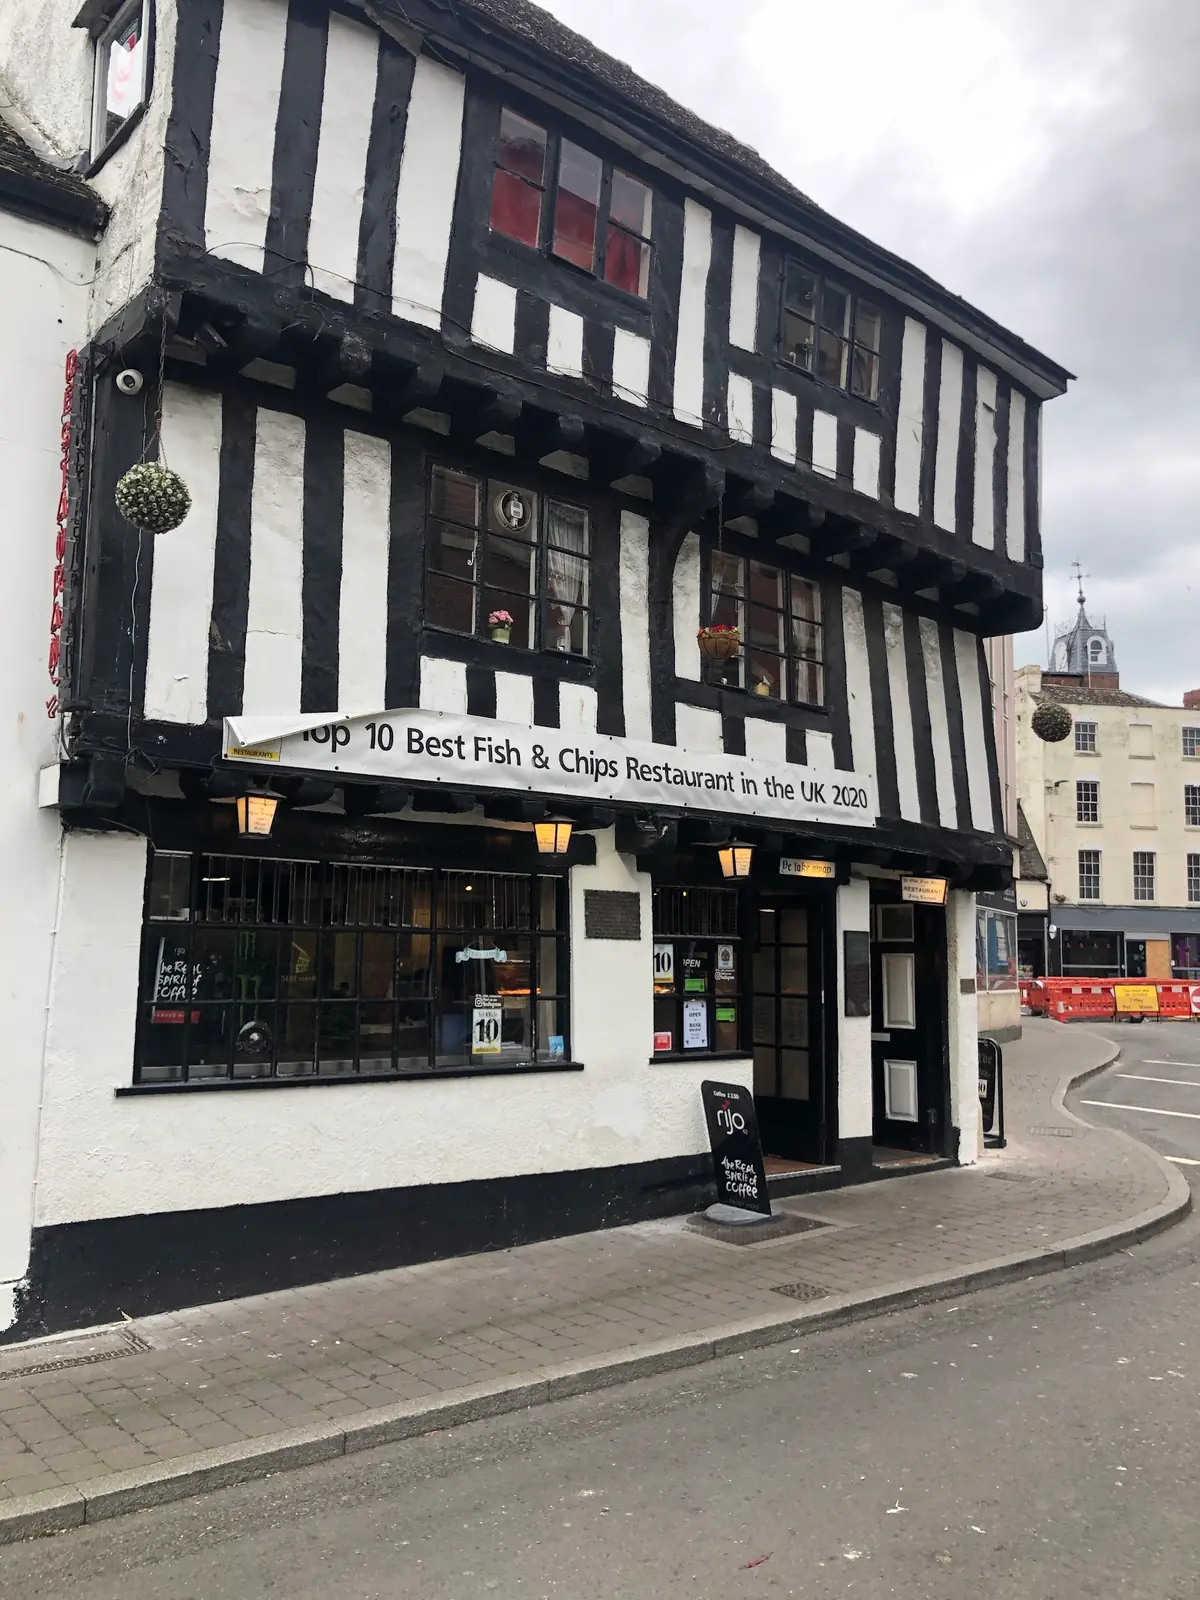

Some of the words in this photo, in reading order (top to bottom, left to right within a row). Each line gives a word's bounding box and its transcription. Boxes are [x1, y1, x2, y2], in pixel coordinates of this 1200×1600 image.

[233, 748, 273, 759] RESTAURANTS
[365, 722, 394, 751] 10
[407, 727, 465, 759] Best
[474, 736, 521, 766] Fish
[532, 744, 550, 770] &
[559, 748, 618, 783] Chips
[625, 756, 735, 793] Restaurant
[741, 771, 758, 796] in
[764, 776, 795, 801] the
[801, 780, 827, 804] UK
[831, 785, 868, 809] 2020
[160, 961, 173, 974] he
[653, 952, 672, 973] 10
[475, 1018, 499, 1044] 10
[716, 1108, 745, 1136] rijo
[749, 1175, 758, 1186] of
